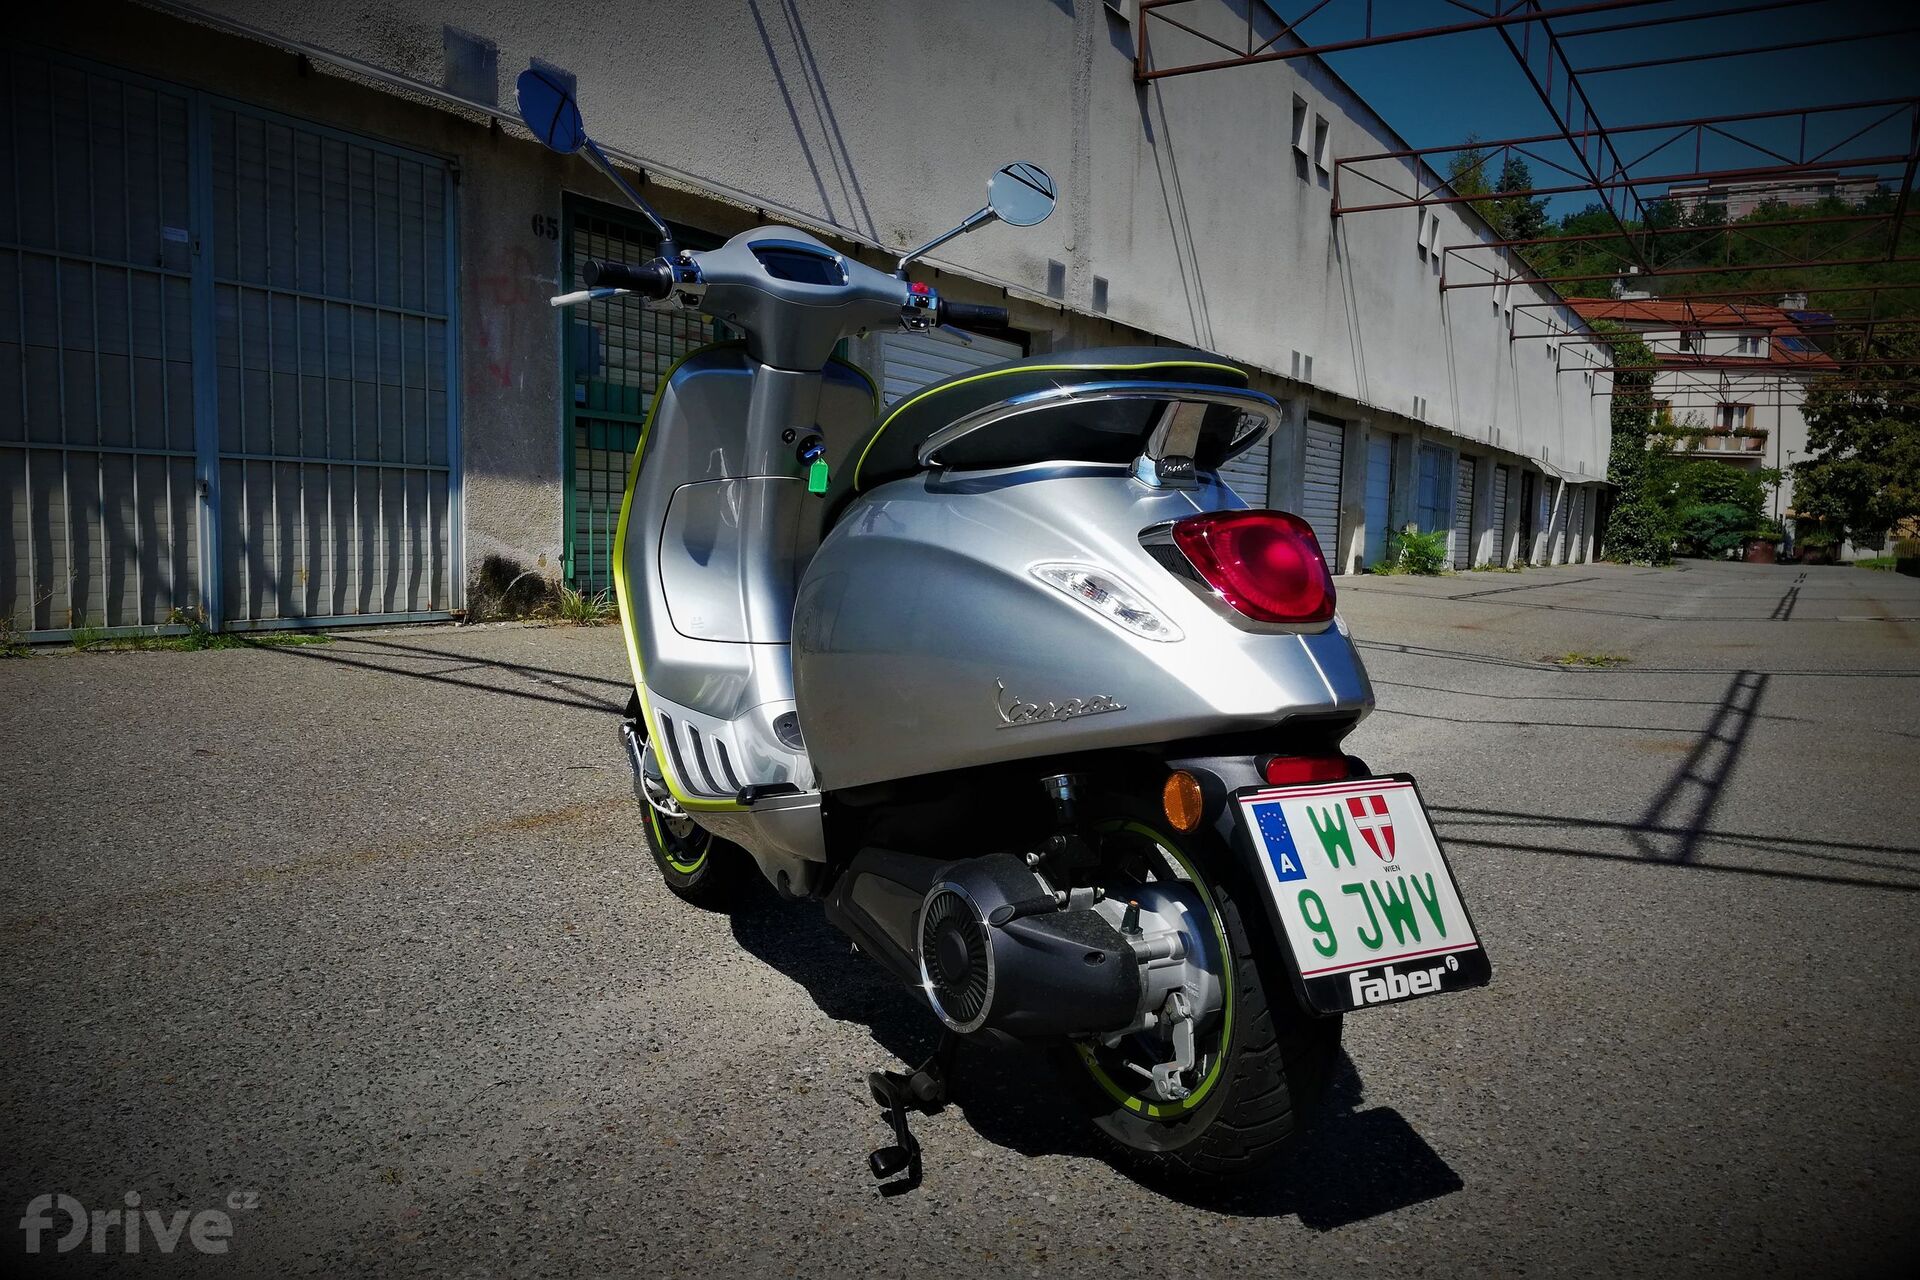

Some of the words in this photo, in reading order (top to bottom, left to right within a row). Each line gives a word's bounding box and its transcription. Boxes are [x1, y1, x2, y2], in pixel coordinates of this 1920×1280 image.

[531, 213, 559, 240] 65
[996, 676, 1127, 730] Vespa
[1306, 802, 1356, 869] W
[1281, 853, 1297, 873] A
[1383, 865, 1401, 873] WIEN
[1297, 888, 1338, 958] 9
[1341, 872, 1447, 950] JWV
[1350, 966, 1446, 1007] Faber
